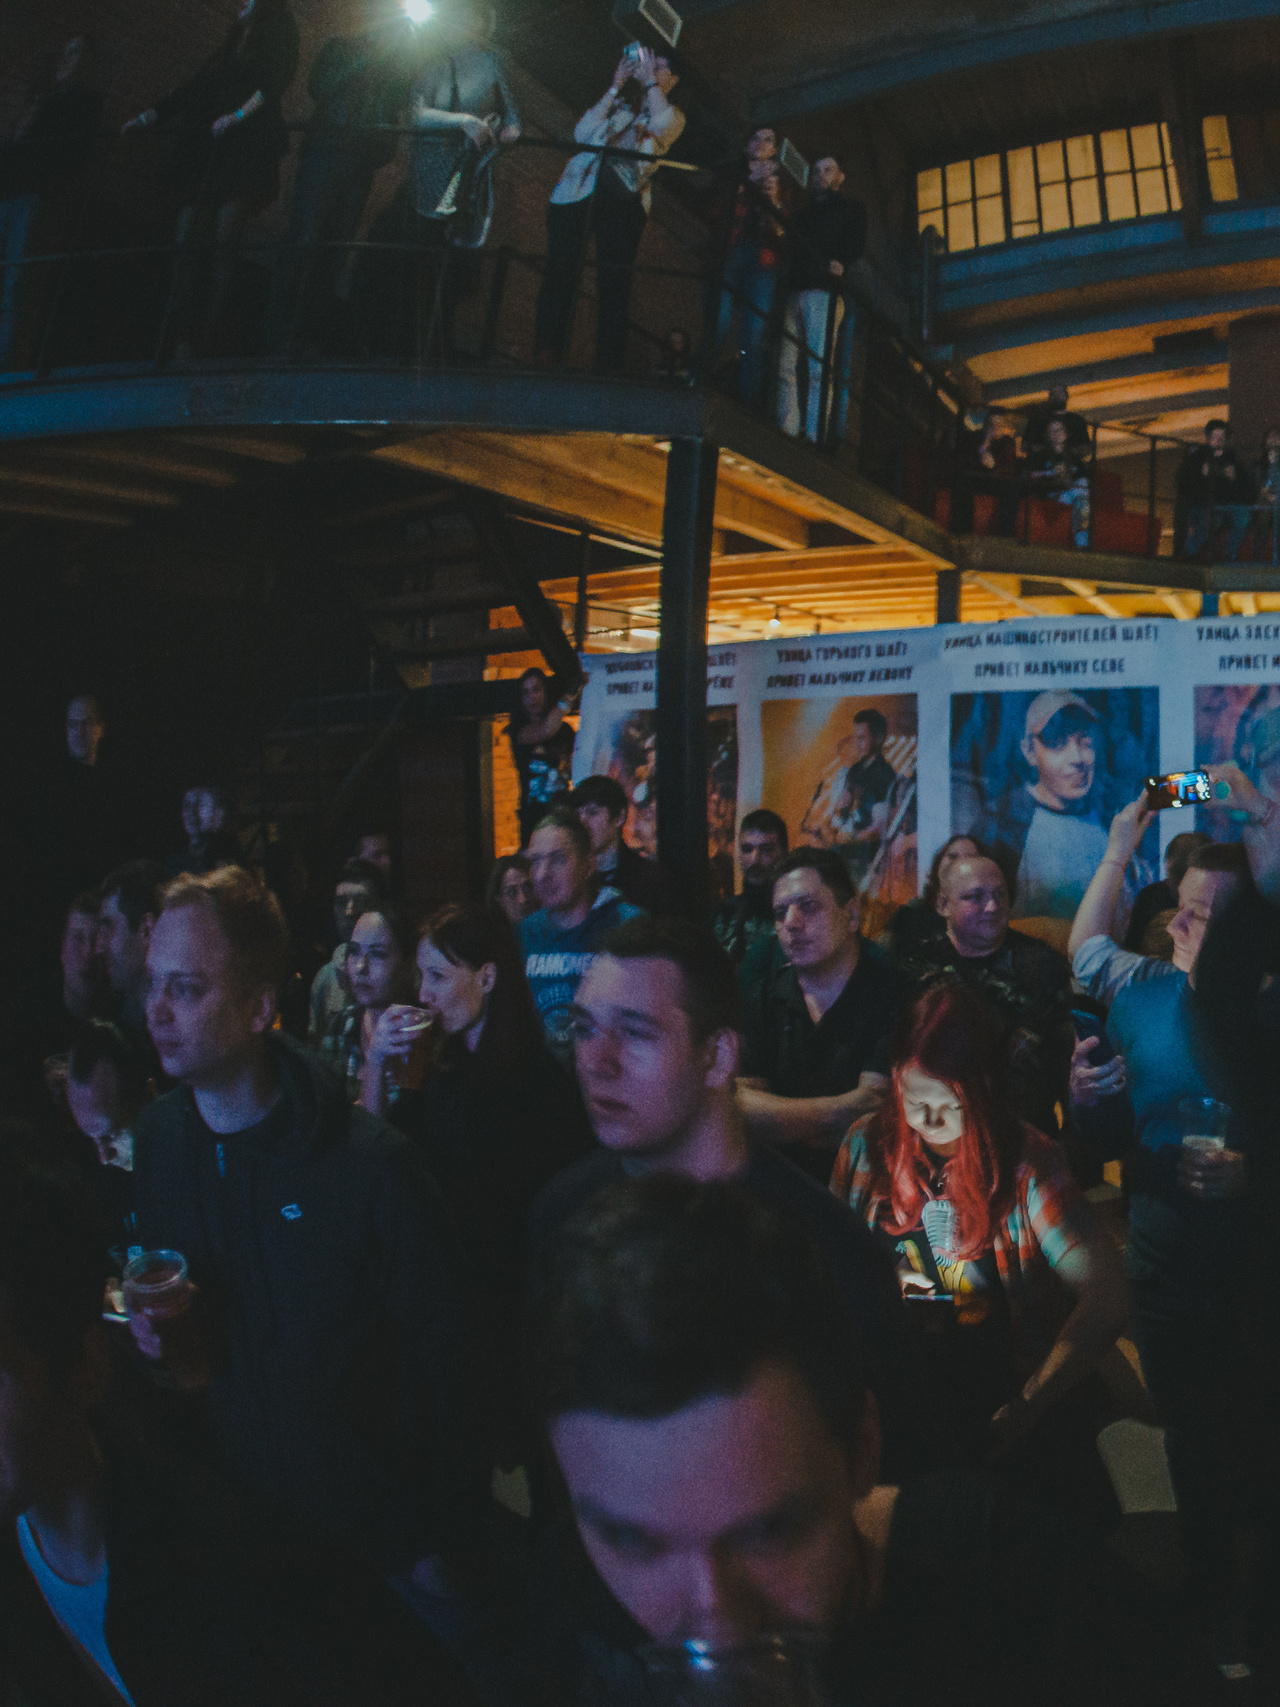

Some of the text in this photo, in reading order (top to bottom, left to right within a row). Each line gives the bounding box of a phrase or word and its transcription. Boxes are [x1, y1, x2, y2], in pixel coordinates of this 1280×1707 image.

[944, 623, 1159, 649] УЛИЦА МАШИНОСТРОИТЕЛЕЙ ШЛЁТ
[1196, 625, 1239, 641] УЛИЦА
[876, 641, 908, 657] ШЛЁТ
[975, 657, 1125, 677] ПРИВЕТ МАЛЬЧИКУ СЕВЕ
[1219, 655, 1267, 670] ПРИВЕТ
[767, 674, 806, 689] ПРИВЕТ
